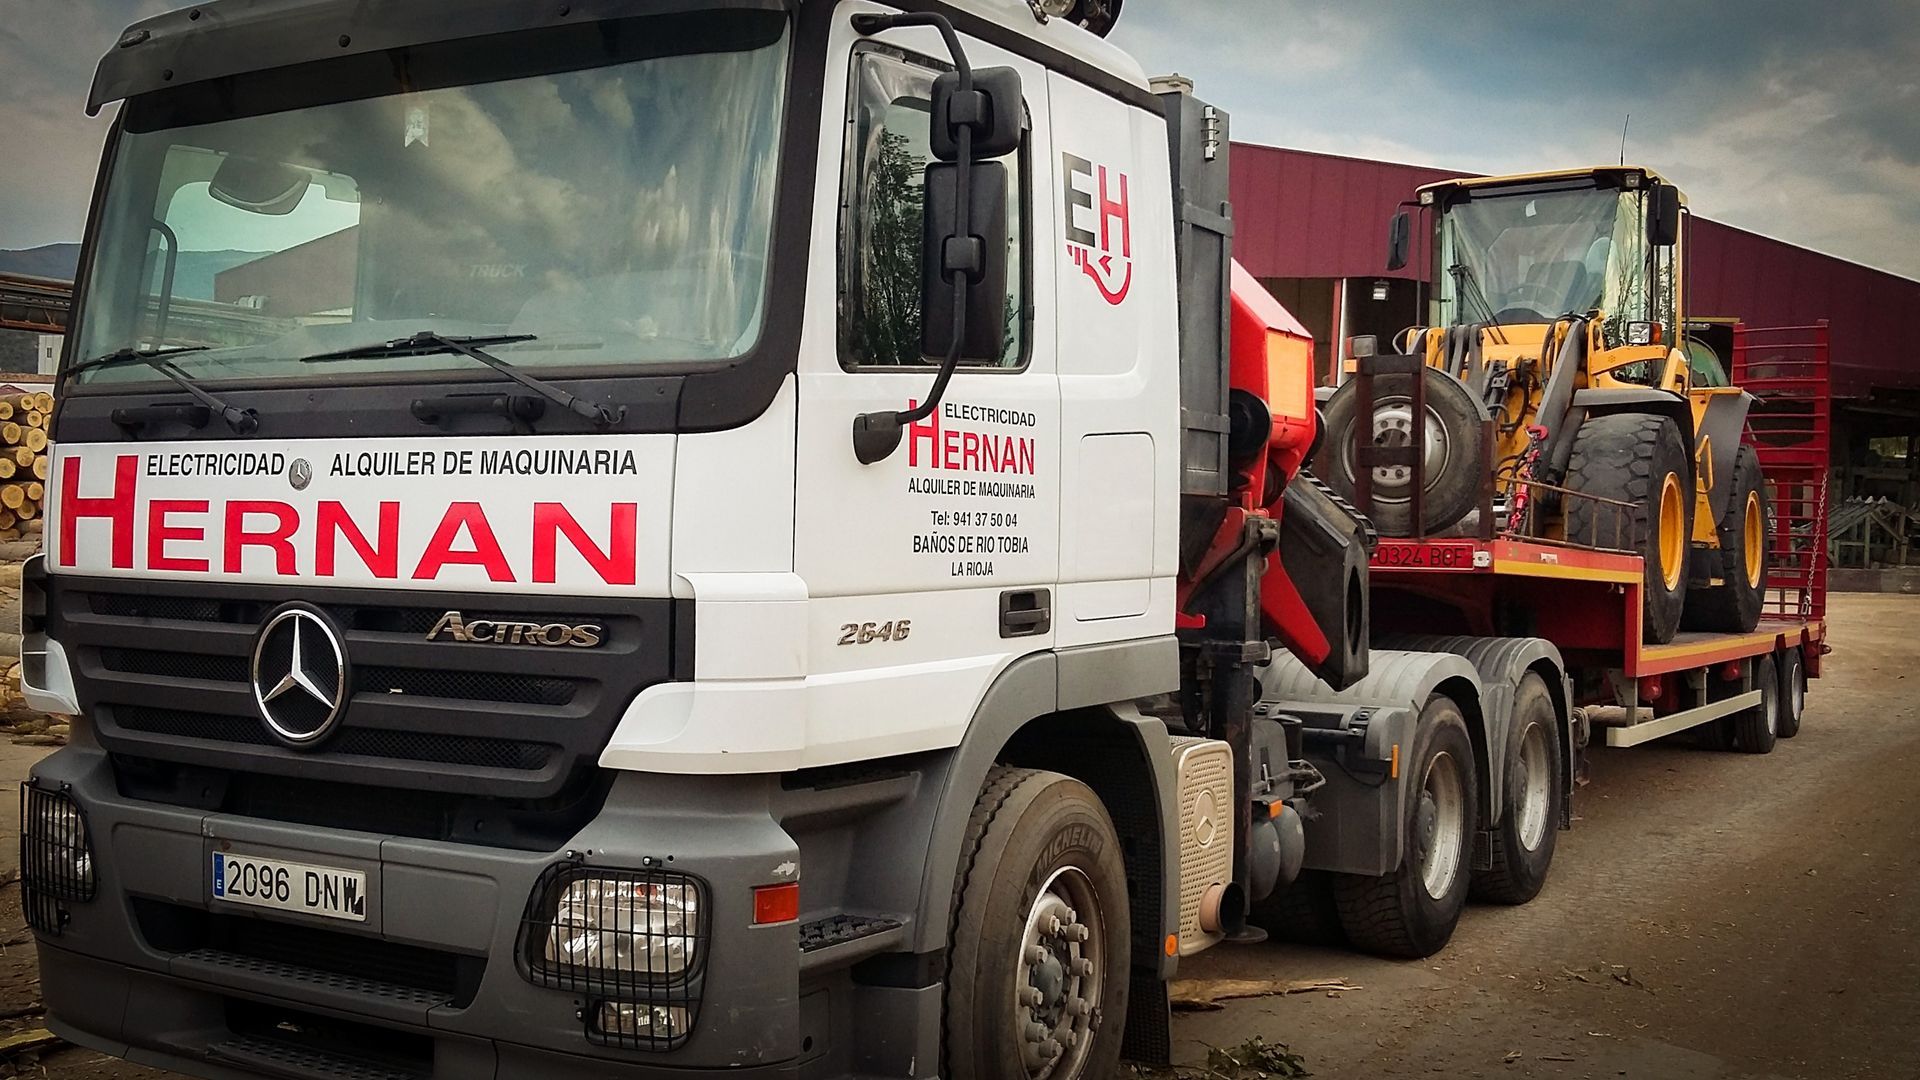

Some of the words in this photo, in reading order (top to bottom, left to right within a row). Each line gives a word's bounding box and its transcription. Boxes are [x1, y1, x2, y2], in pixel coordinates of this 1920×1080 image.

[469, 264, 529, 278] TRUCK
[945, 403, 1036, 427] ELECTRICIDAD
[908, 399, 1035, 475] HERNAN
[147, 452, 285, 476] ELECTRICIDAD
[330, 451, 436, 476] ALQUILER
[443, 451, 473, 475] DE
[480, 450, 638, 475] MAQUINARIA
[908, 477, 961, 496] ALQUILER
[963, 481, 976, 496] DE
[978, 481, 1036, 499] MAQUINARIA
[60, 455, 637, 585] HERNAN
[931, 511, 950, 526] Tel:
[953, 512, 971, 526] 941
[975, 512, 987, 527] 37
[990, 513, 1003, 527] 50
[1005, 513, 1018, 527] 04
[913, 531, 956, 554] BAÑOS
[958, 536, 973, 553] DE
[976, 536, 995, 553] RIO
[998, 536, 1029, 554] TOBIA
[1377, 547, 1423, 566] 0324
[951, 561, 964, 577] LA
[966, 561, 994, 576] RIOJA
[837, 619, 911, 647] 2646
[1036, 825, 1104, 882] MICHELIN
[216, 879, 222, 889] E
[227, 860, 290, 902] 2096
[305, 871, 358, 914] DNW
